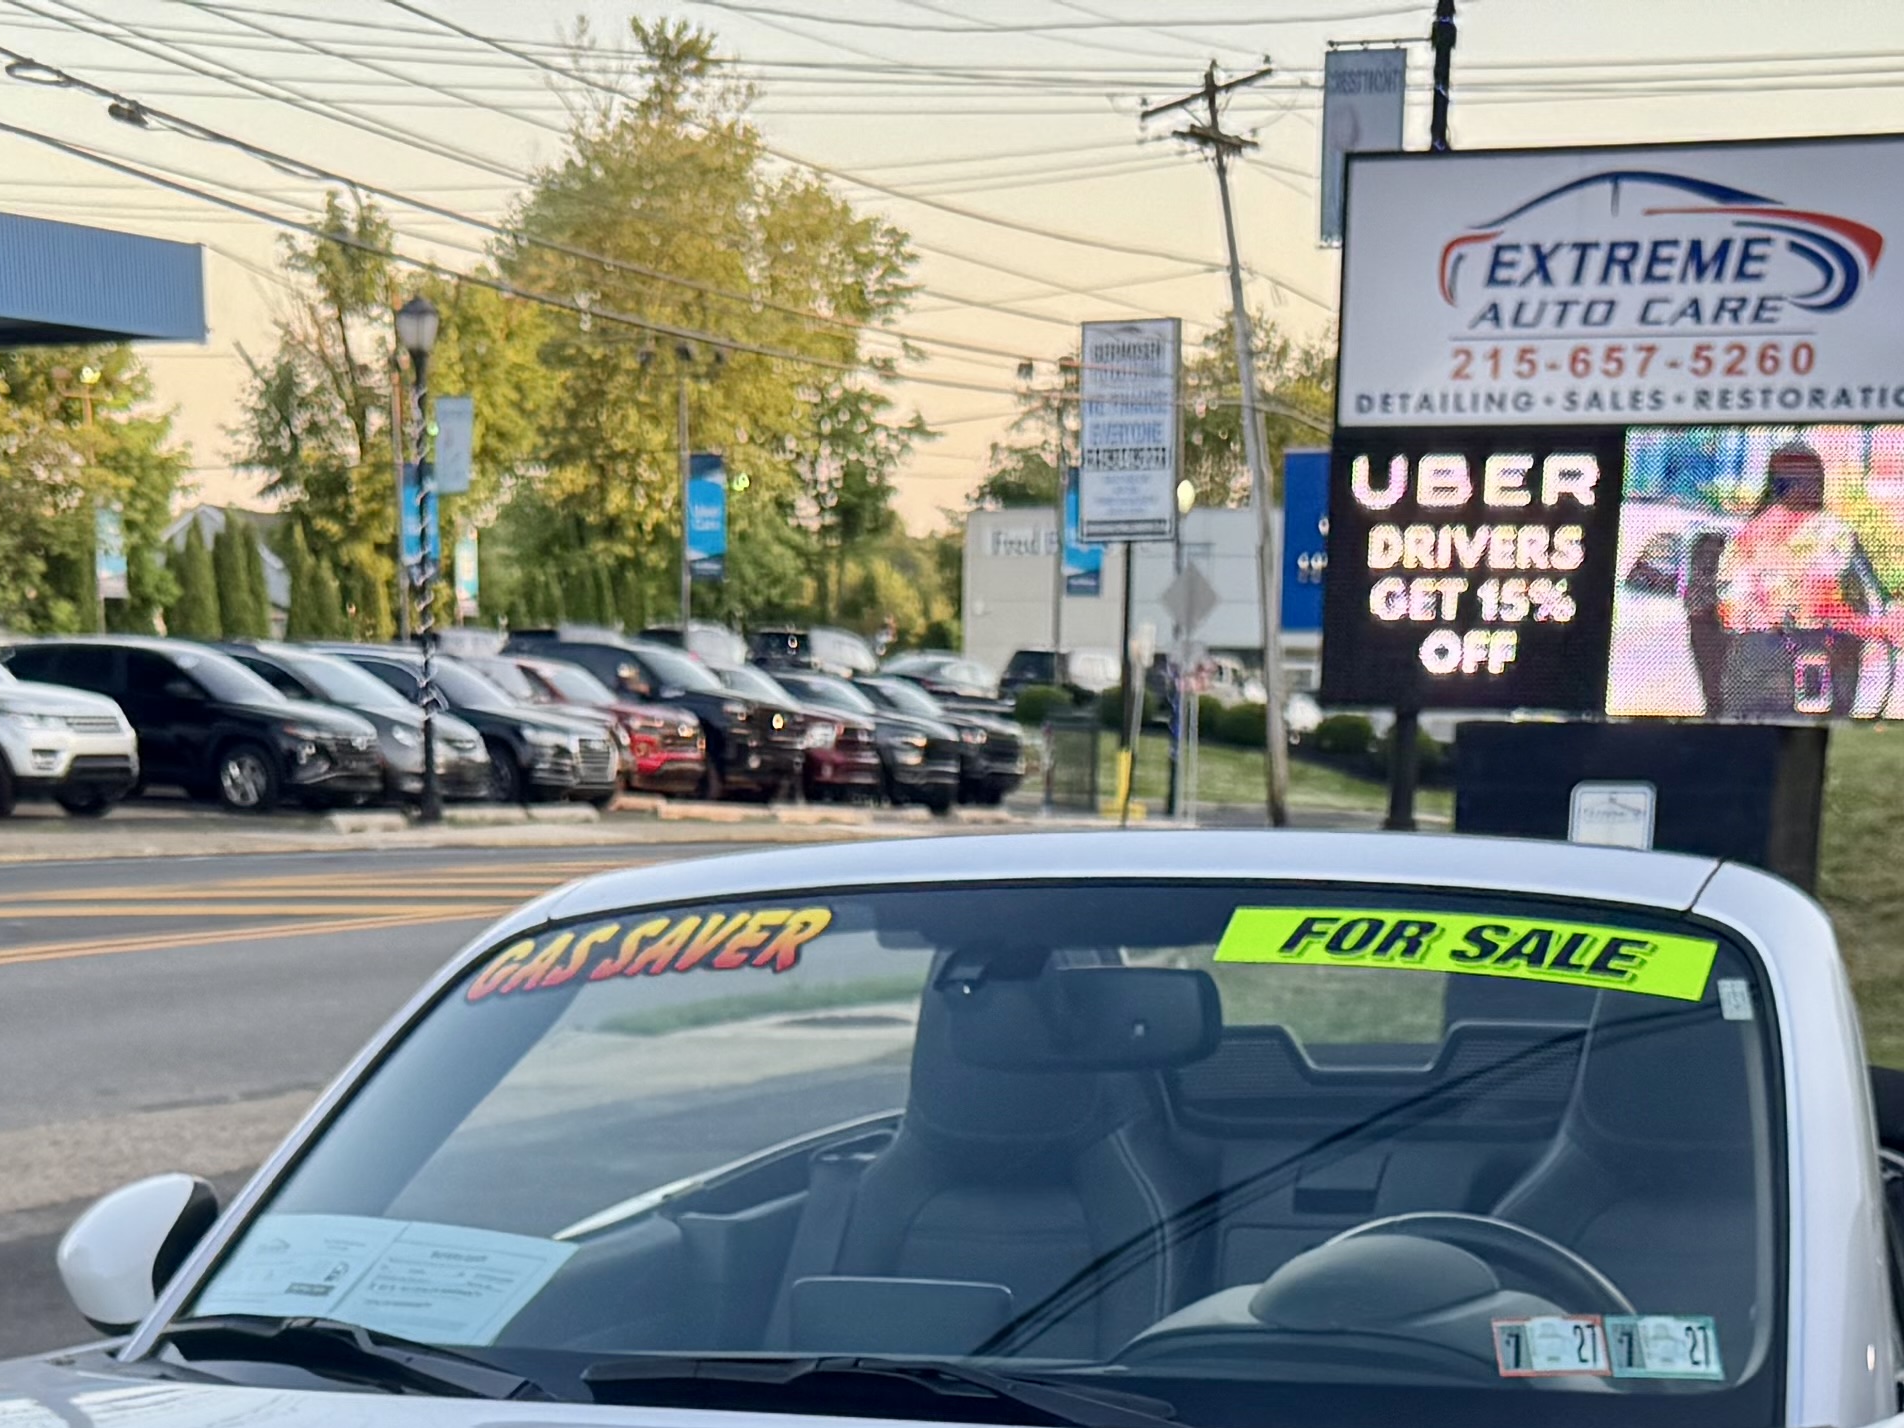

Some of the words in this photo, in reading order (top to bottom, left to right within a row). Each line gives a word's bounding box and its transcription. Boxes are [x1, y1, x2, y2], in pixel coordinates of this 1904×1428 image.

[1483, 236, 1775, 288] EXTREME
[1467, 298, 1618, 330] AUTO
[1637, 297, 1789, 327] CARE
[1448, 341, 1815, 381] 215-657-5260
[1355, 390, 1534, 415] DETAILING
[1562, 390, 1666, 412] SALES
[1351, 452, 1601, 511] UBER
[1367, 523, 1586, 570] DRIVERS
[1369, 576, 1469, 621] GET
[1477, 577, 1577, 622] 15%
[1418, 628, 1518, 674] OFF
[466, 922, 621, 1000] GAS
[589, 907, 832, 981] SAVER
[1279, 916, 1442, 961] FOR
[1449, 923, 1658, 985] SALE
[1572, 1324, 1597, 1365] 27
[1684, 1325, 1710, 1365] 27
